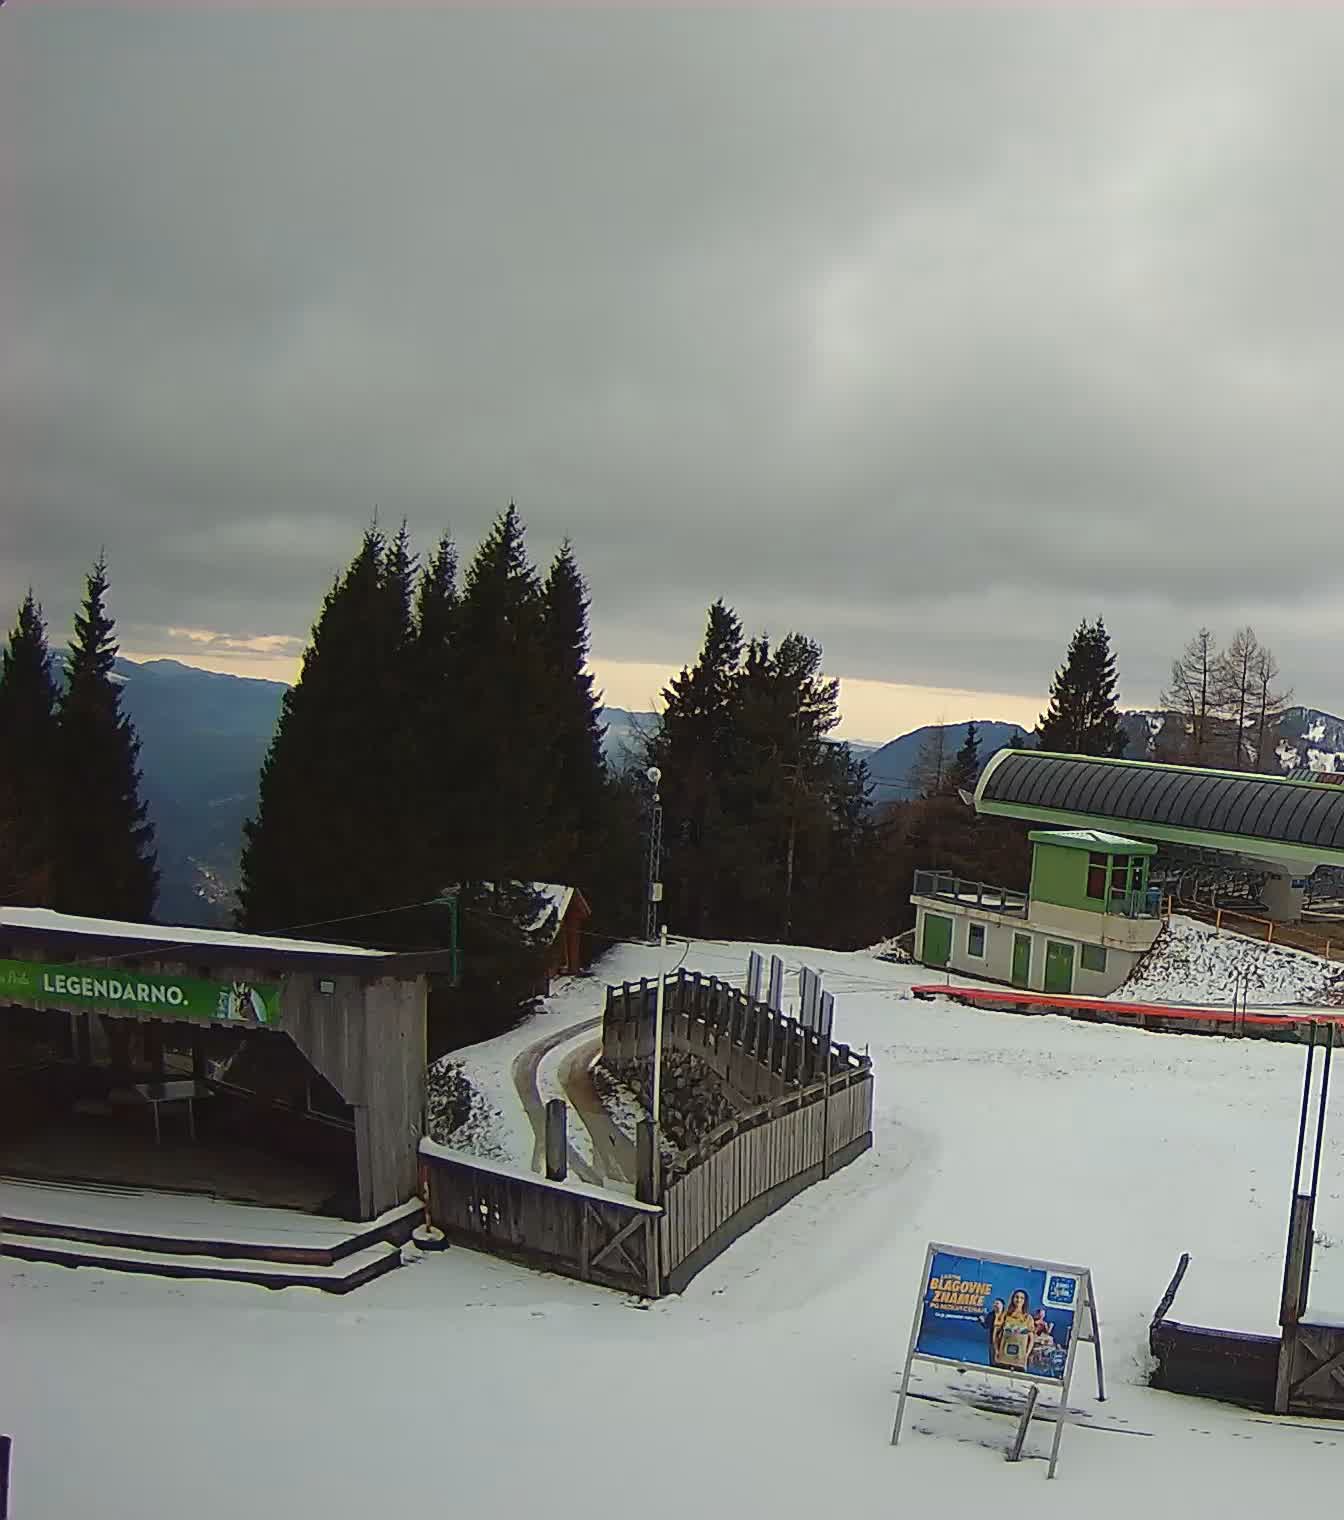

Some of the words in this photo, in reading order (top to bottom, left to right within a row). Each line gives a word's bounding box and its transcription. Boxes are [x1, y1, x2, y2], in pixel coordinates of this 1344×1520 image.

[41, 972, 190, 1006] LEGENDARNO.
[930, 1277, 993, 1295] BLAGOVNE
[932, 1290, 985, 1307] ZNAMKE
